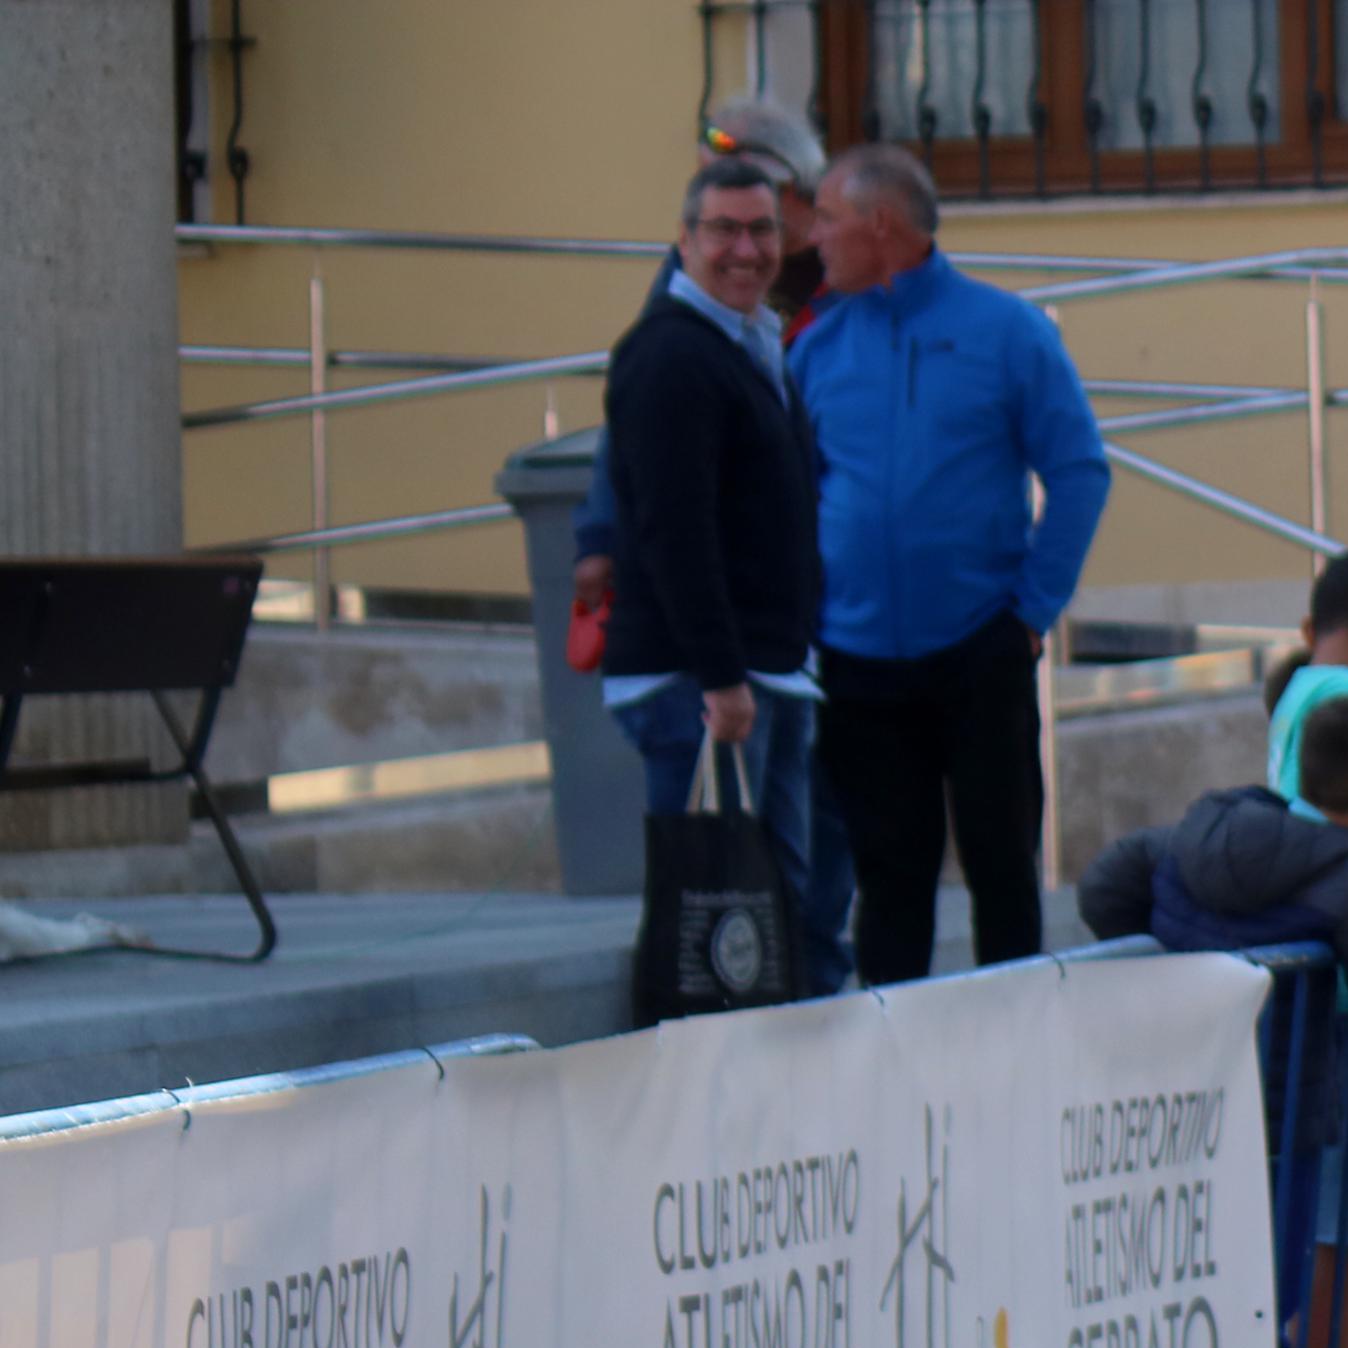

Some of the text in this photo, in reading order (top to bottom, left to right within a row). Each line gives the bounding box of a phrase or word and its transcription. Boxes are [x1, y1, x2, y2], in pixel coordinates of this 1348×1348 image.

[1060, 1086, 1224, 1187] CLUB DEPORTIVO
[653, 1147, 859, 1275] CLUB DEPORTIVO
[1064, 1186, 1166, 1309] ATLETISMO
[1173, 1180, 1216, 1282] DEL
